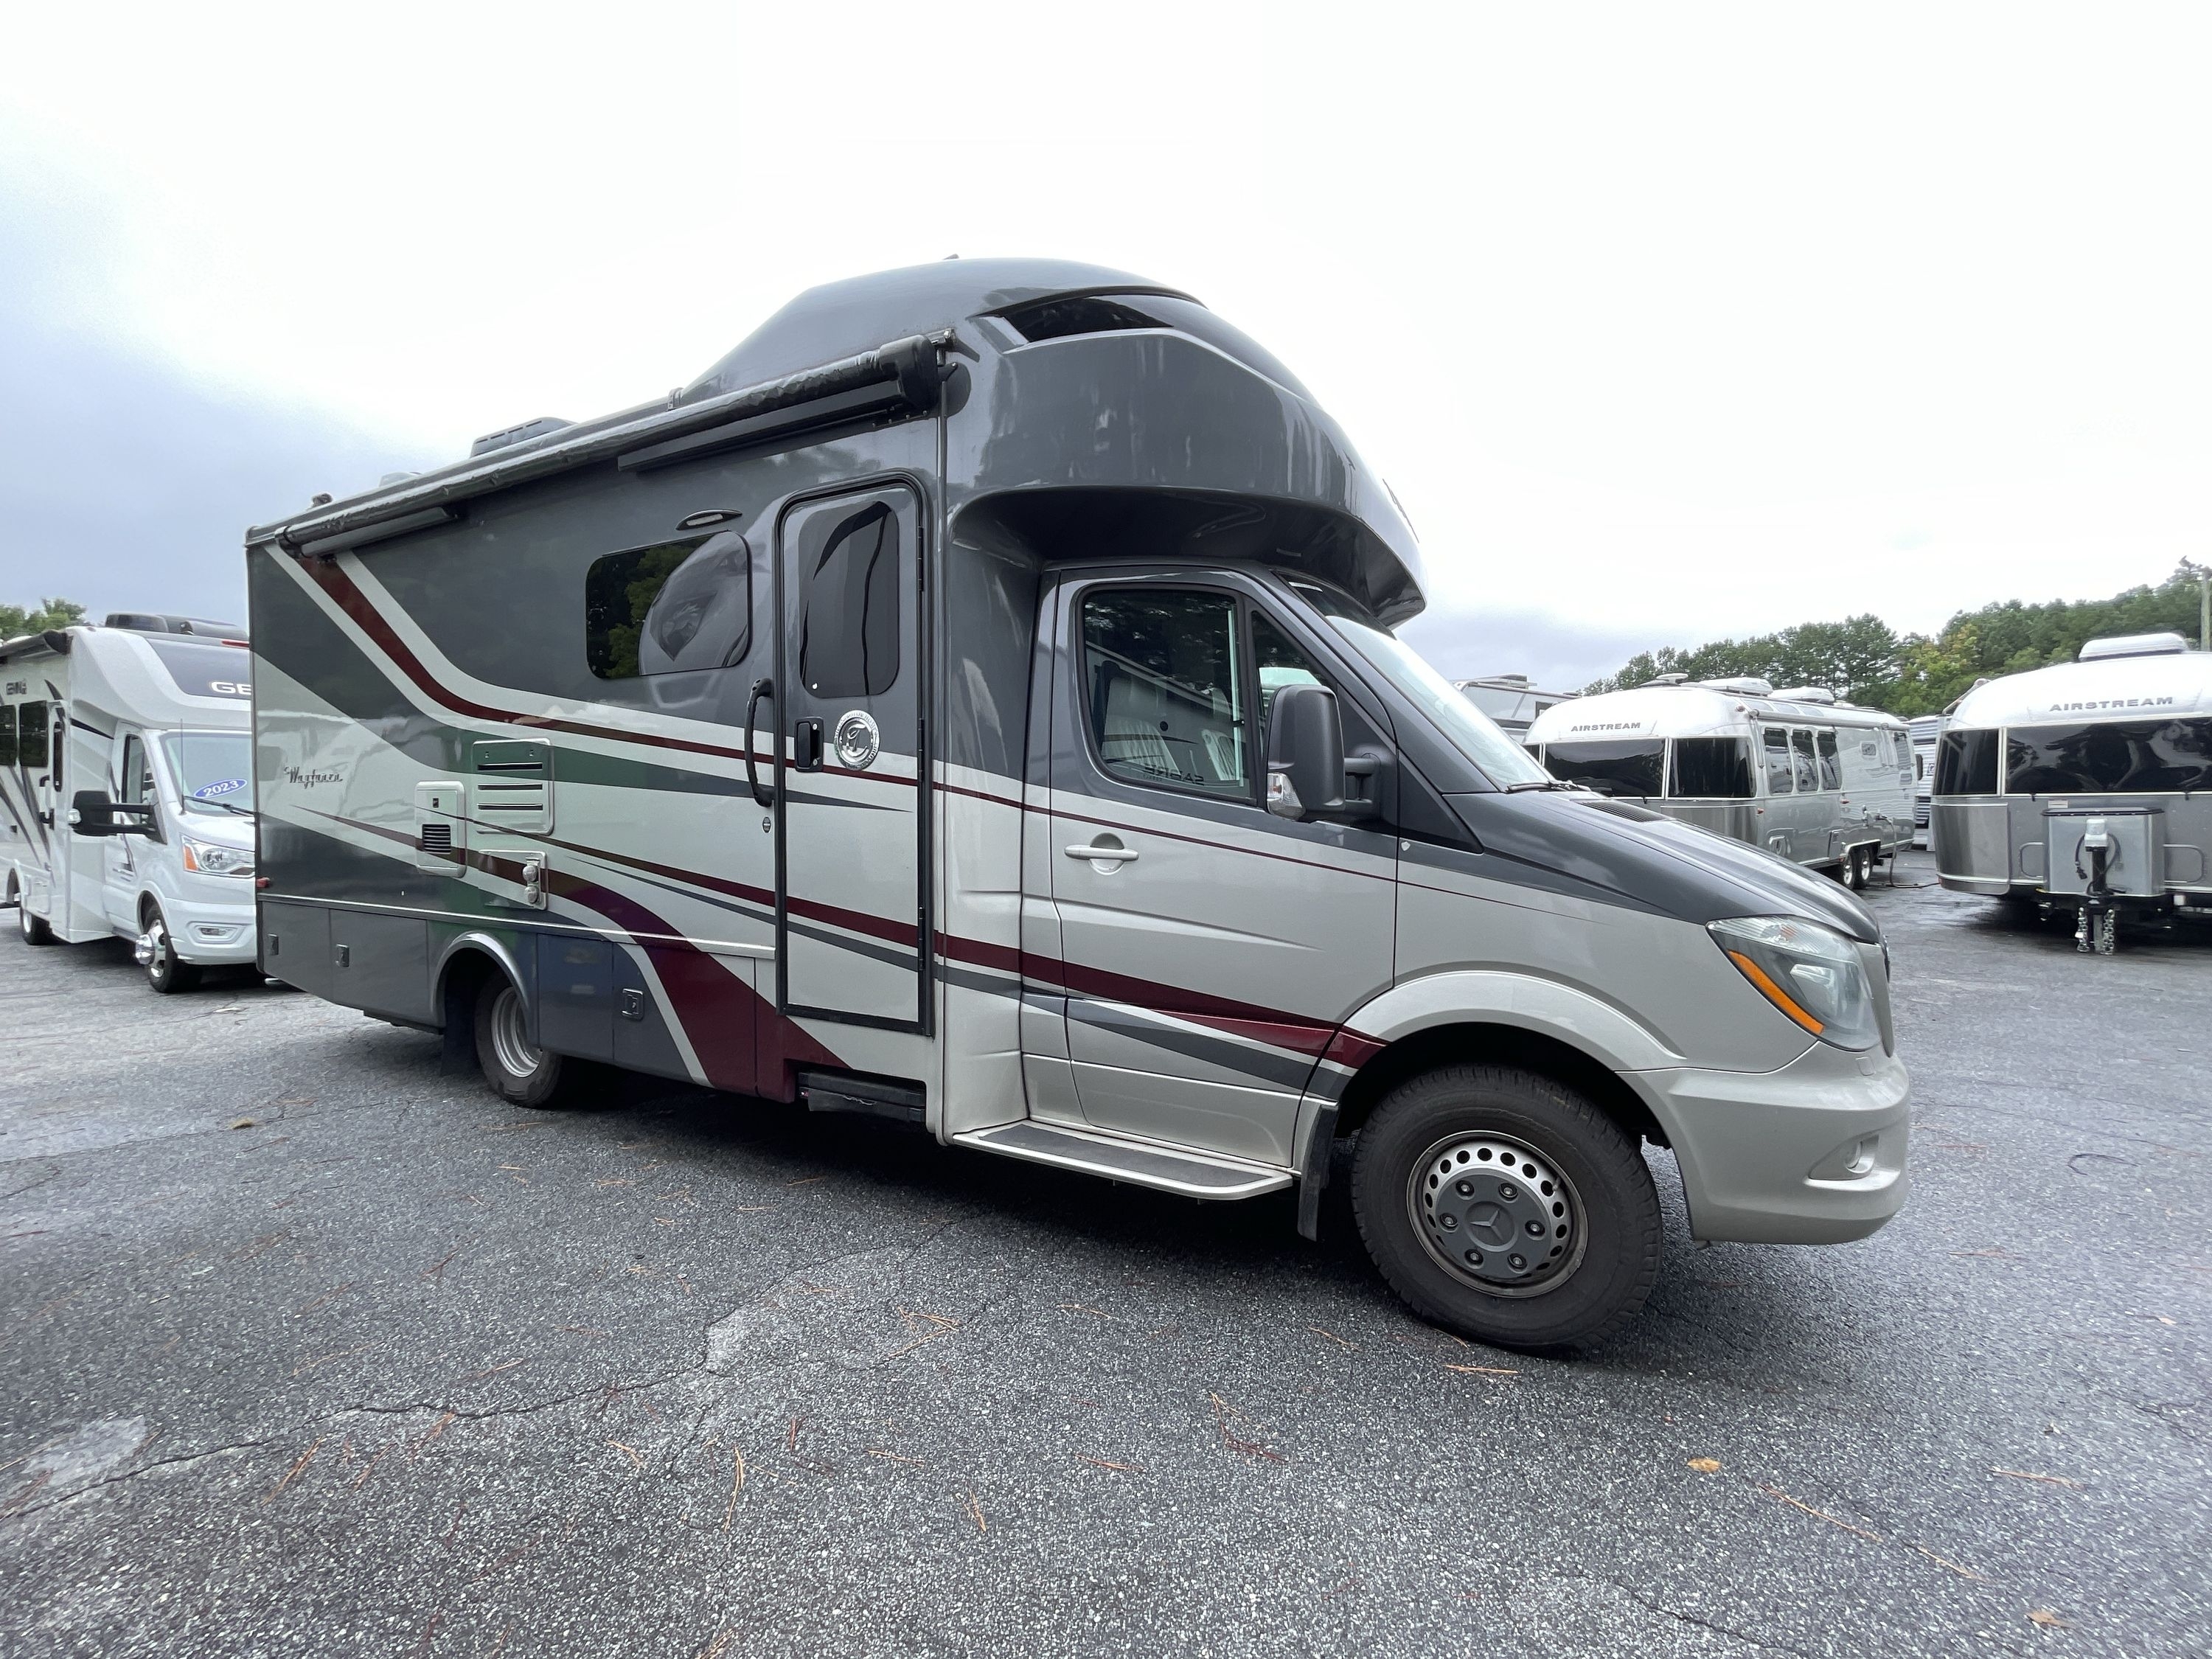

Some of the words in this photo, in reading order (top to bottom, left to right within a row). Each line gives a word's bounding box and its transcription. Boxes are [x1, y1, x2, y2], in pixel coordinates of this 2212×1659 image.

[211, 681, 252, 695] GE
[2048, 697, 2174, 712] AIRSTREAM
[1571, 722, 1641, 732] AIRSTREAM
[203, 780, 240, 797] 2023
